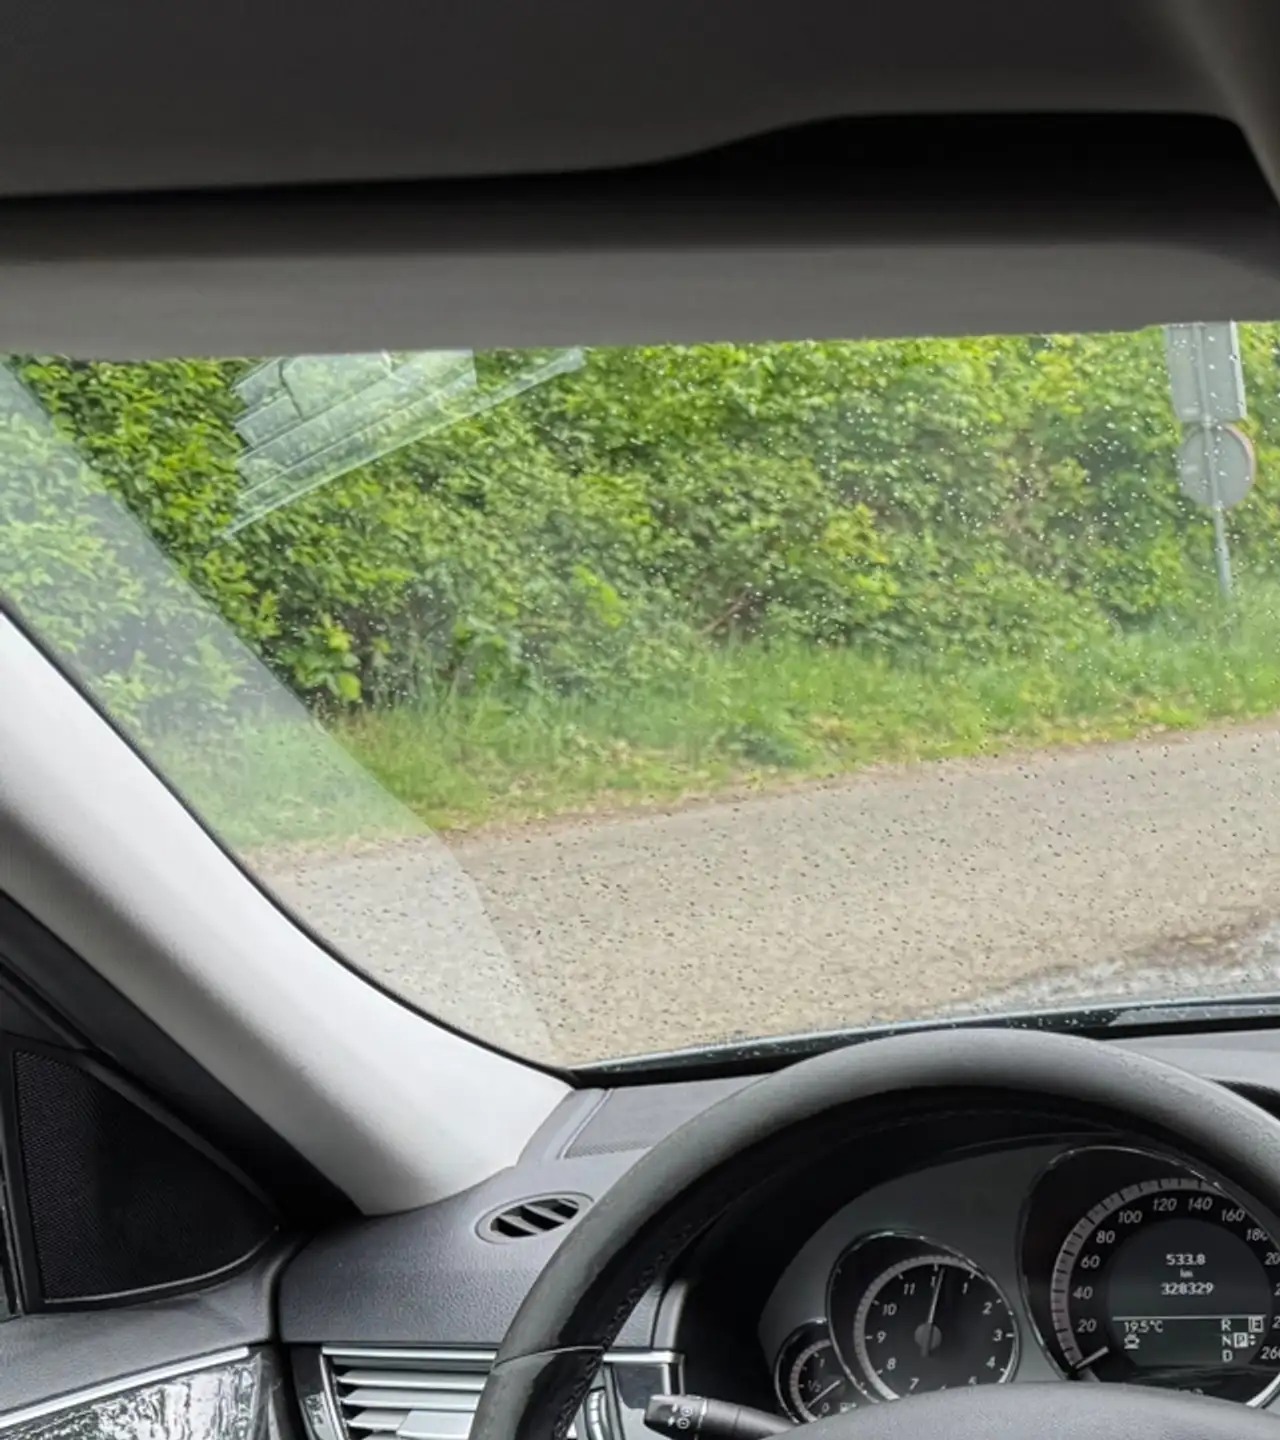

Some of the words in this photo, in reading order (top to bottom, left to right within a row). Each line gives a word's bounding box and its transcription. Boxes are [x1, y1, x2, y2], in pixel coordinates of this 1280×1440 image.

[1153, 1197, 1178, 1212] 120
[1187, 1196, 1213, 1211] 140
[1118, 1209, 1143, 1224] 100
[1221, 1208, 1245, 1223] 160
[1096, 1230, 1116, 1245] 80
[1080, 1255, 1100, 1270] 60
[903, 1282, 916, 1296] 11
[1073, 1286, 1093, 1300] 40
[883, 1302, 898, 1317] 10
[982, 1302, 993, 1315] 2
[1077, 1319, 1097, 1333] 20
[1221, 1319, 1231, 1332] R
[877, 1331, 887, 1344] 9
[993, 1330, 1003, 1342] 3
[1222, 1335, 1231, 1347] N
[986, 1355, 996, 1370] 4
[1222, 1350, 1232, 1362] D
[886, 1357, 897, 1371] 8
[909, 1377, 920, 1391] 7
